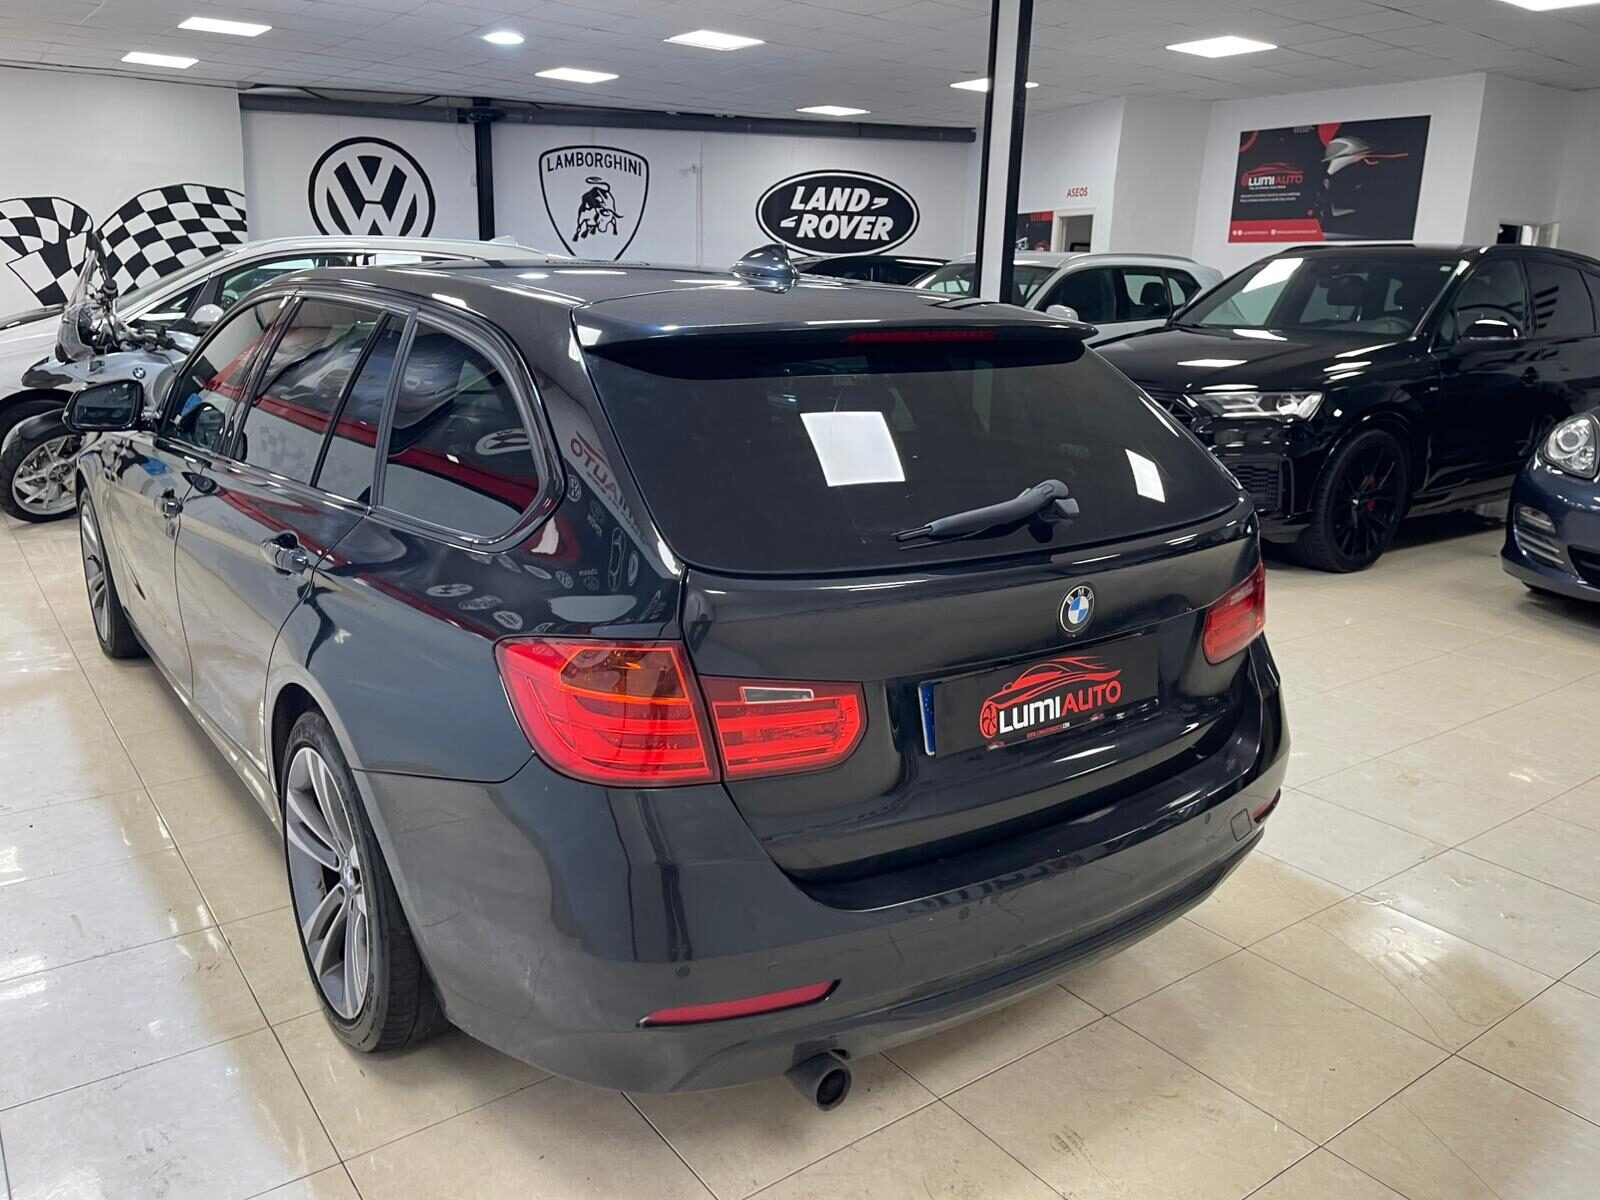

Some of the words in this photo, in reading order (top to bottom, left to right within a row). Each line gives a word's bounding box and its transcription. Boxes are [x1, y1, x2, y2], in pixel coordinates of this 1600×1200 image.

[546, 151, 642, 177] LAMBORGHINI
[316, 146, 427, 236] VW
[790, 185, 871, 212] LAND
[1066, 187, 1088, 198] ASEOS
[796, 213, 894, 241] ROVER
[1065, 587, 1094, 605] BMW
